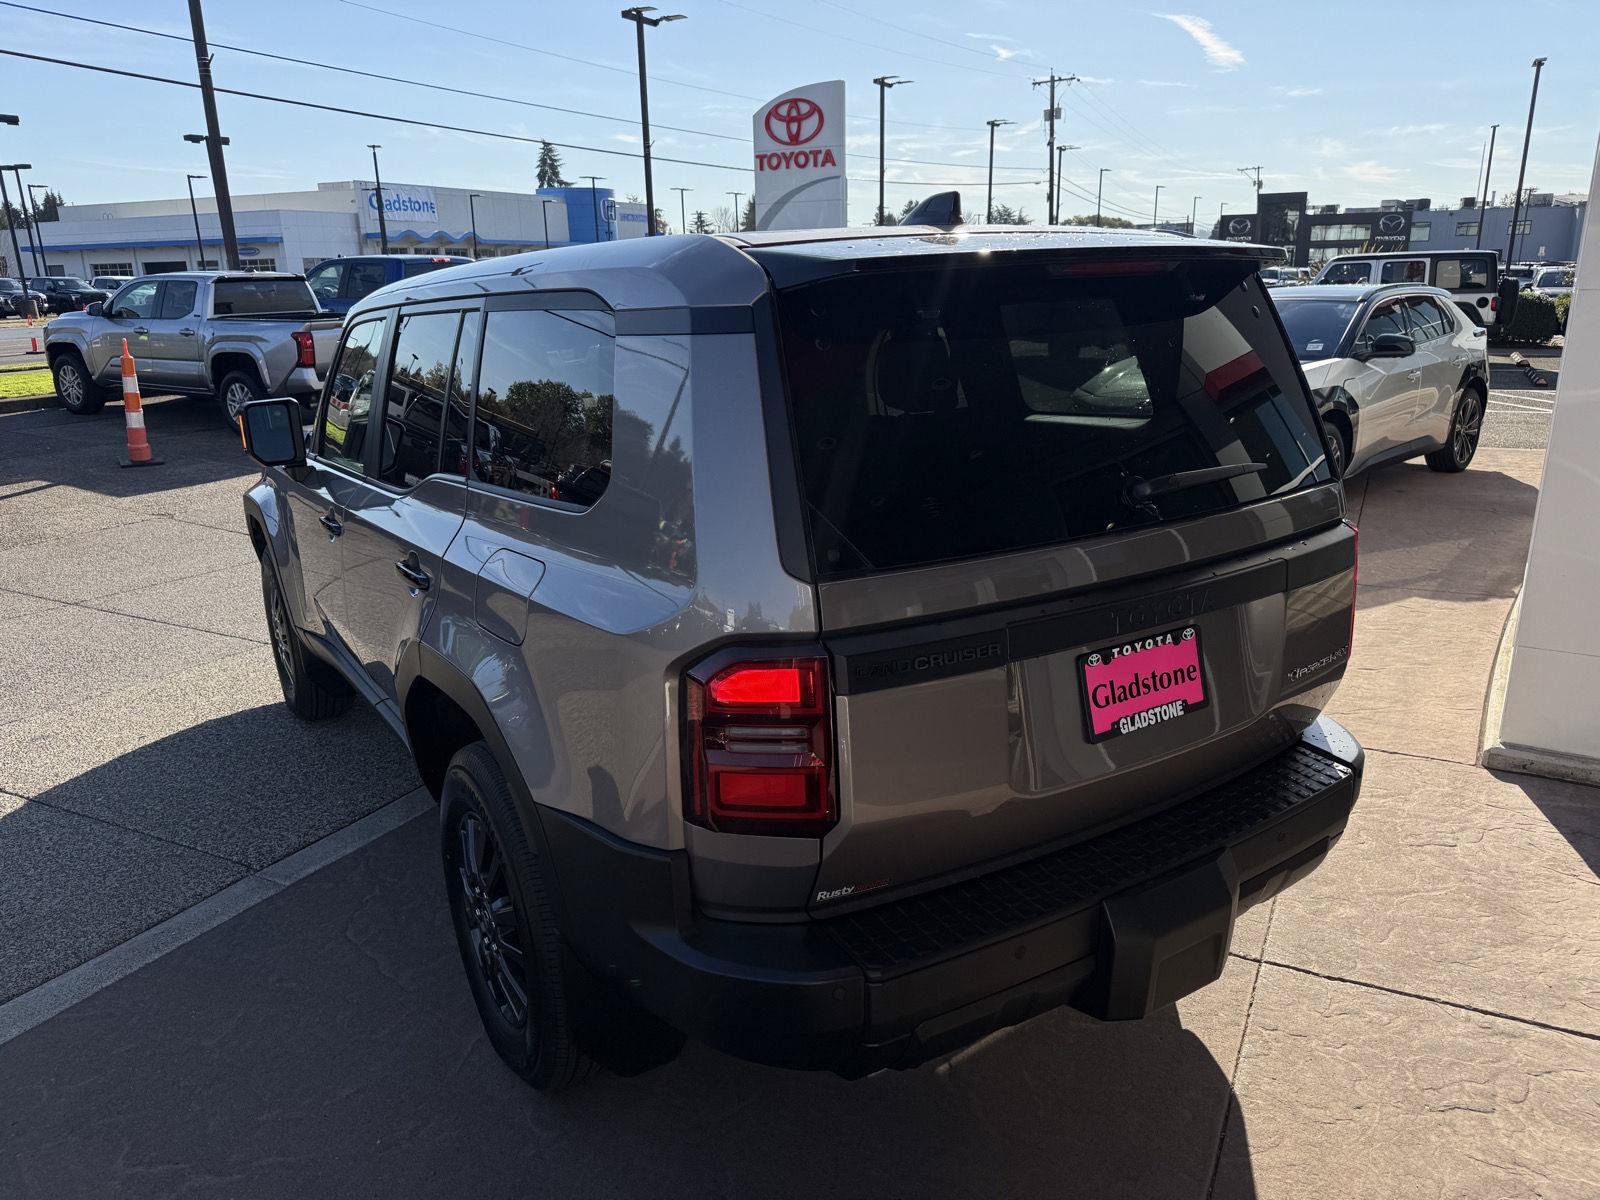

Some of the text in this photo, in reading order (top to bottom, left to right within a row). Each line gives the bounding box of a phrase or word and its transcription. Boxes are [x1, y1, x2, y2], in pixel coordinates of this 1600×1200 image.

[755, 149, 837, 171] TOYOTA
[368, 192, 436, 214] Gadstone
[914, 643, 1001, 670] CRUISER
[1110, 633, 1174, 659] TOYOTA
[1091, 663, 1199, 709] Gladstone
[1119, 700, 1185, 734] GLADSTONE
